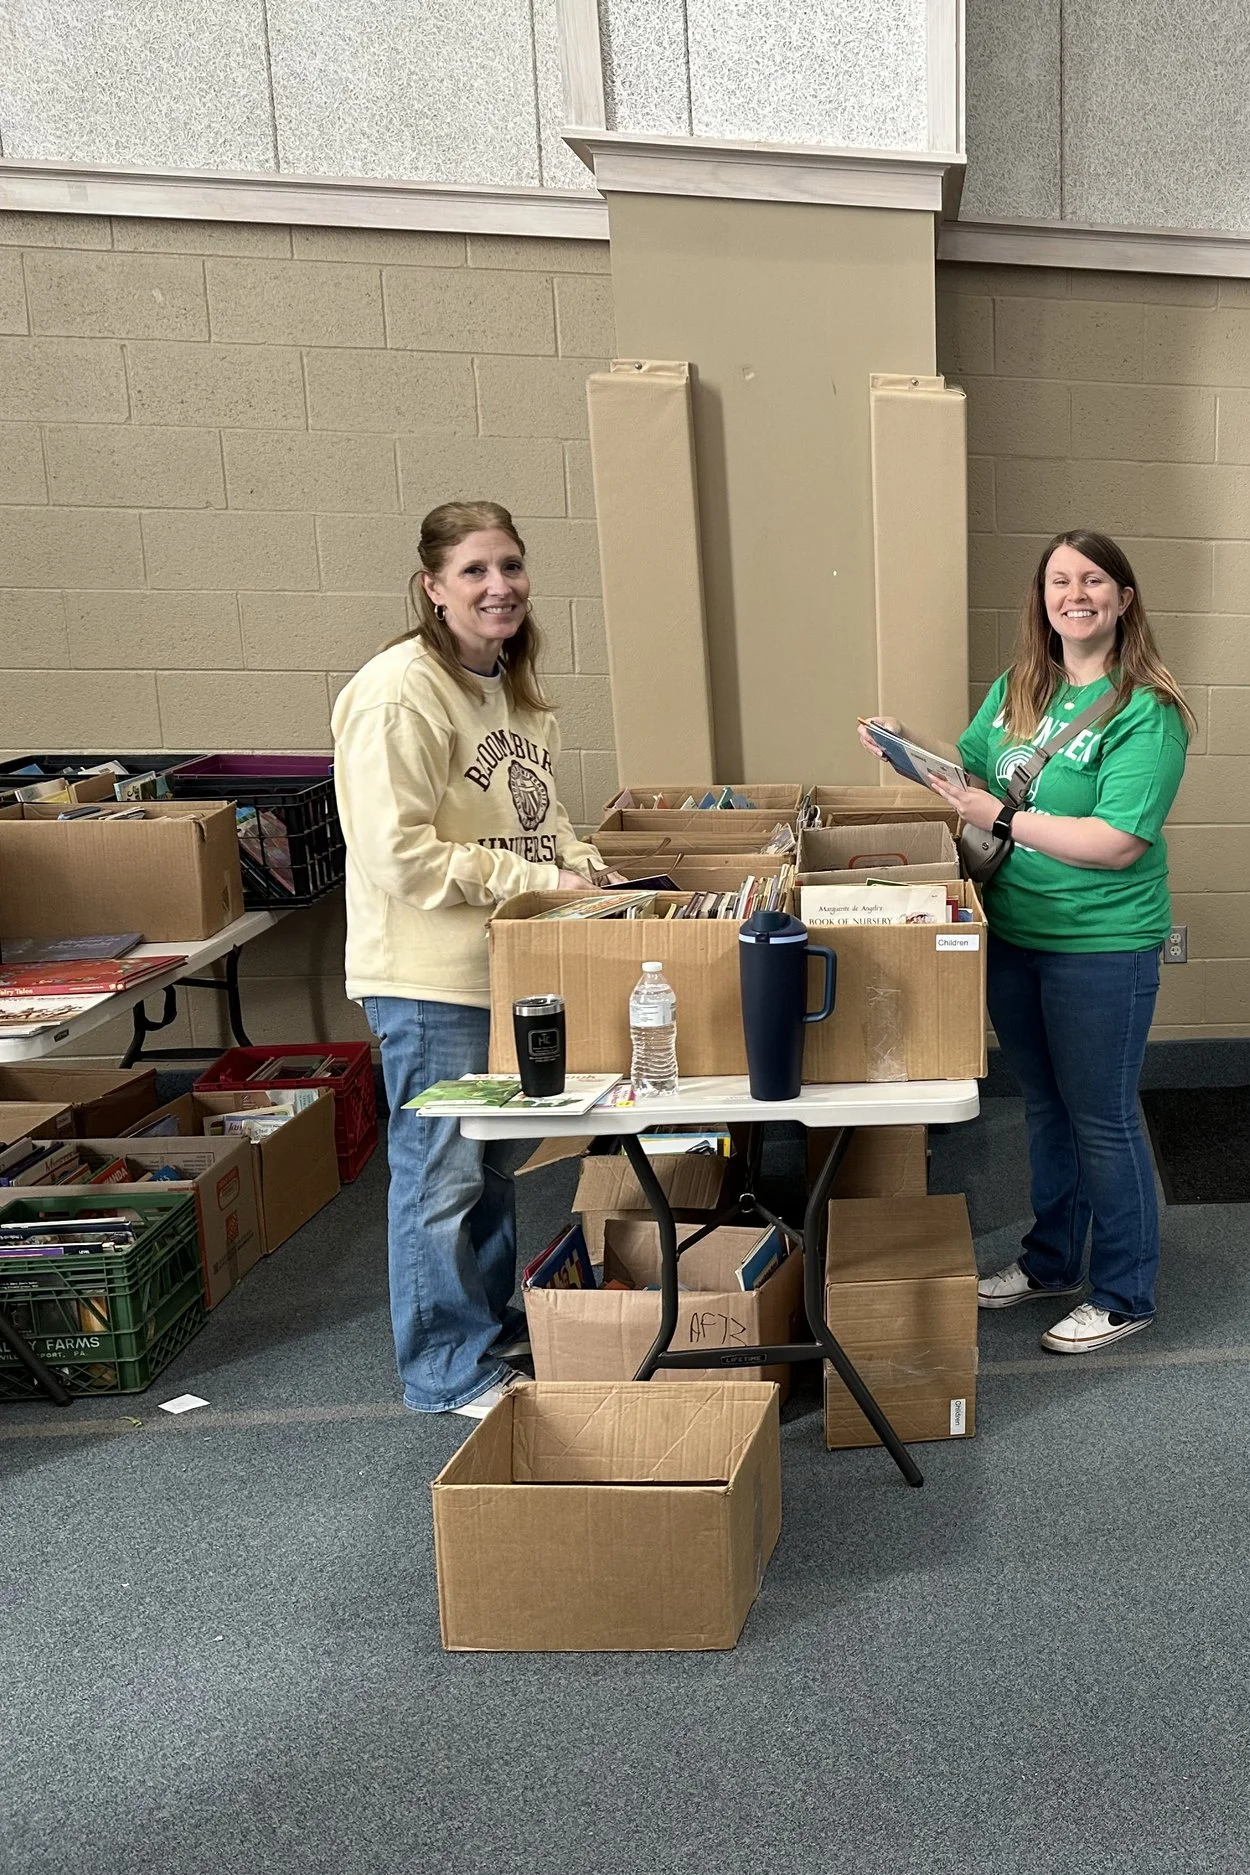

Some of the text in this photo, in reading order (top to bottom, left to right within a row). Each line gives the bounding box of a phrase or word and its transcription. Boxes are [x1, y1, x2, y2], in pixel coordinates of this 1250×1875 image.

[853, 917, 893, 925] NURSERY
[938, 938, 969, 947] Children
[46, 1337, 100, 1350] FARMS
[725, 1355, 762, 1363] LIFETIME
[954, 1400, 962, 1426] Children
